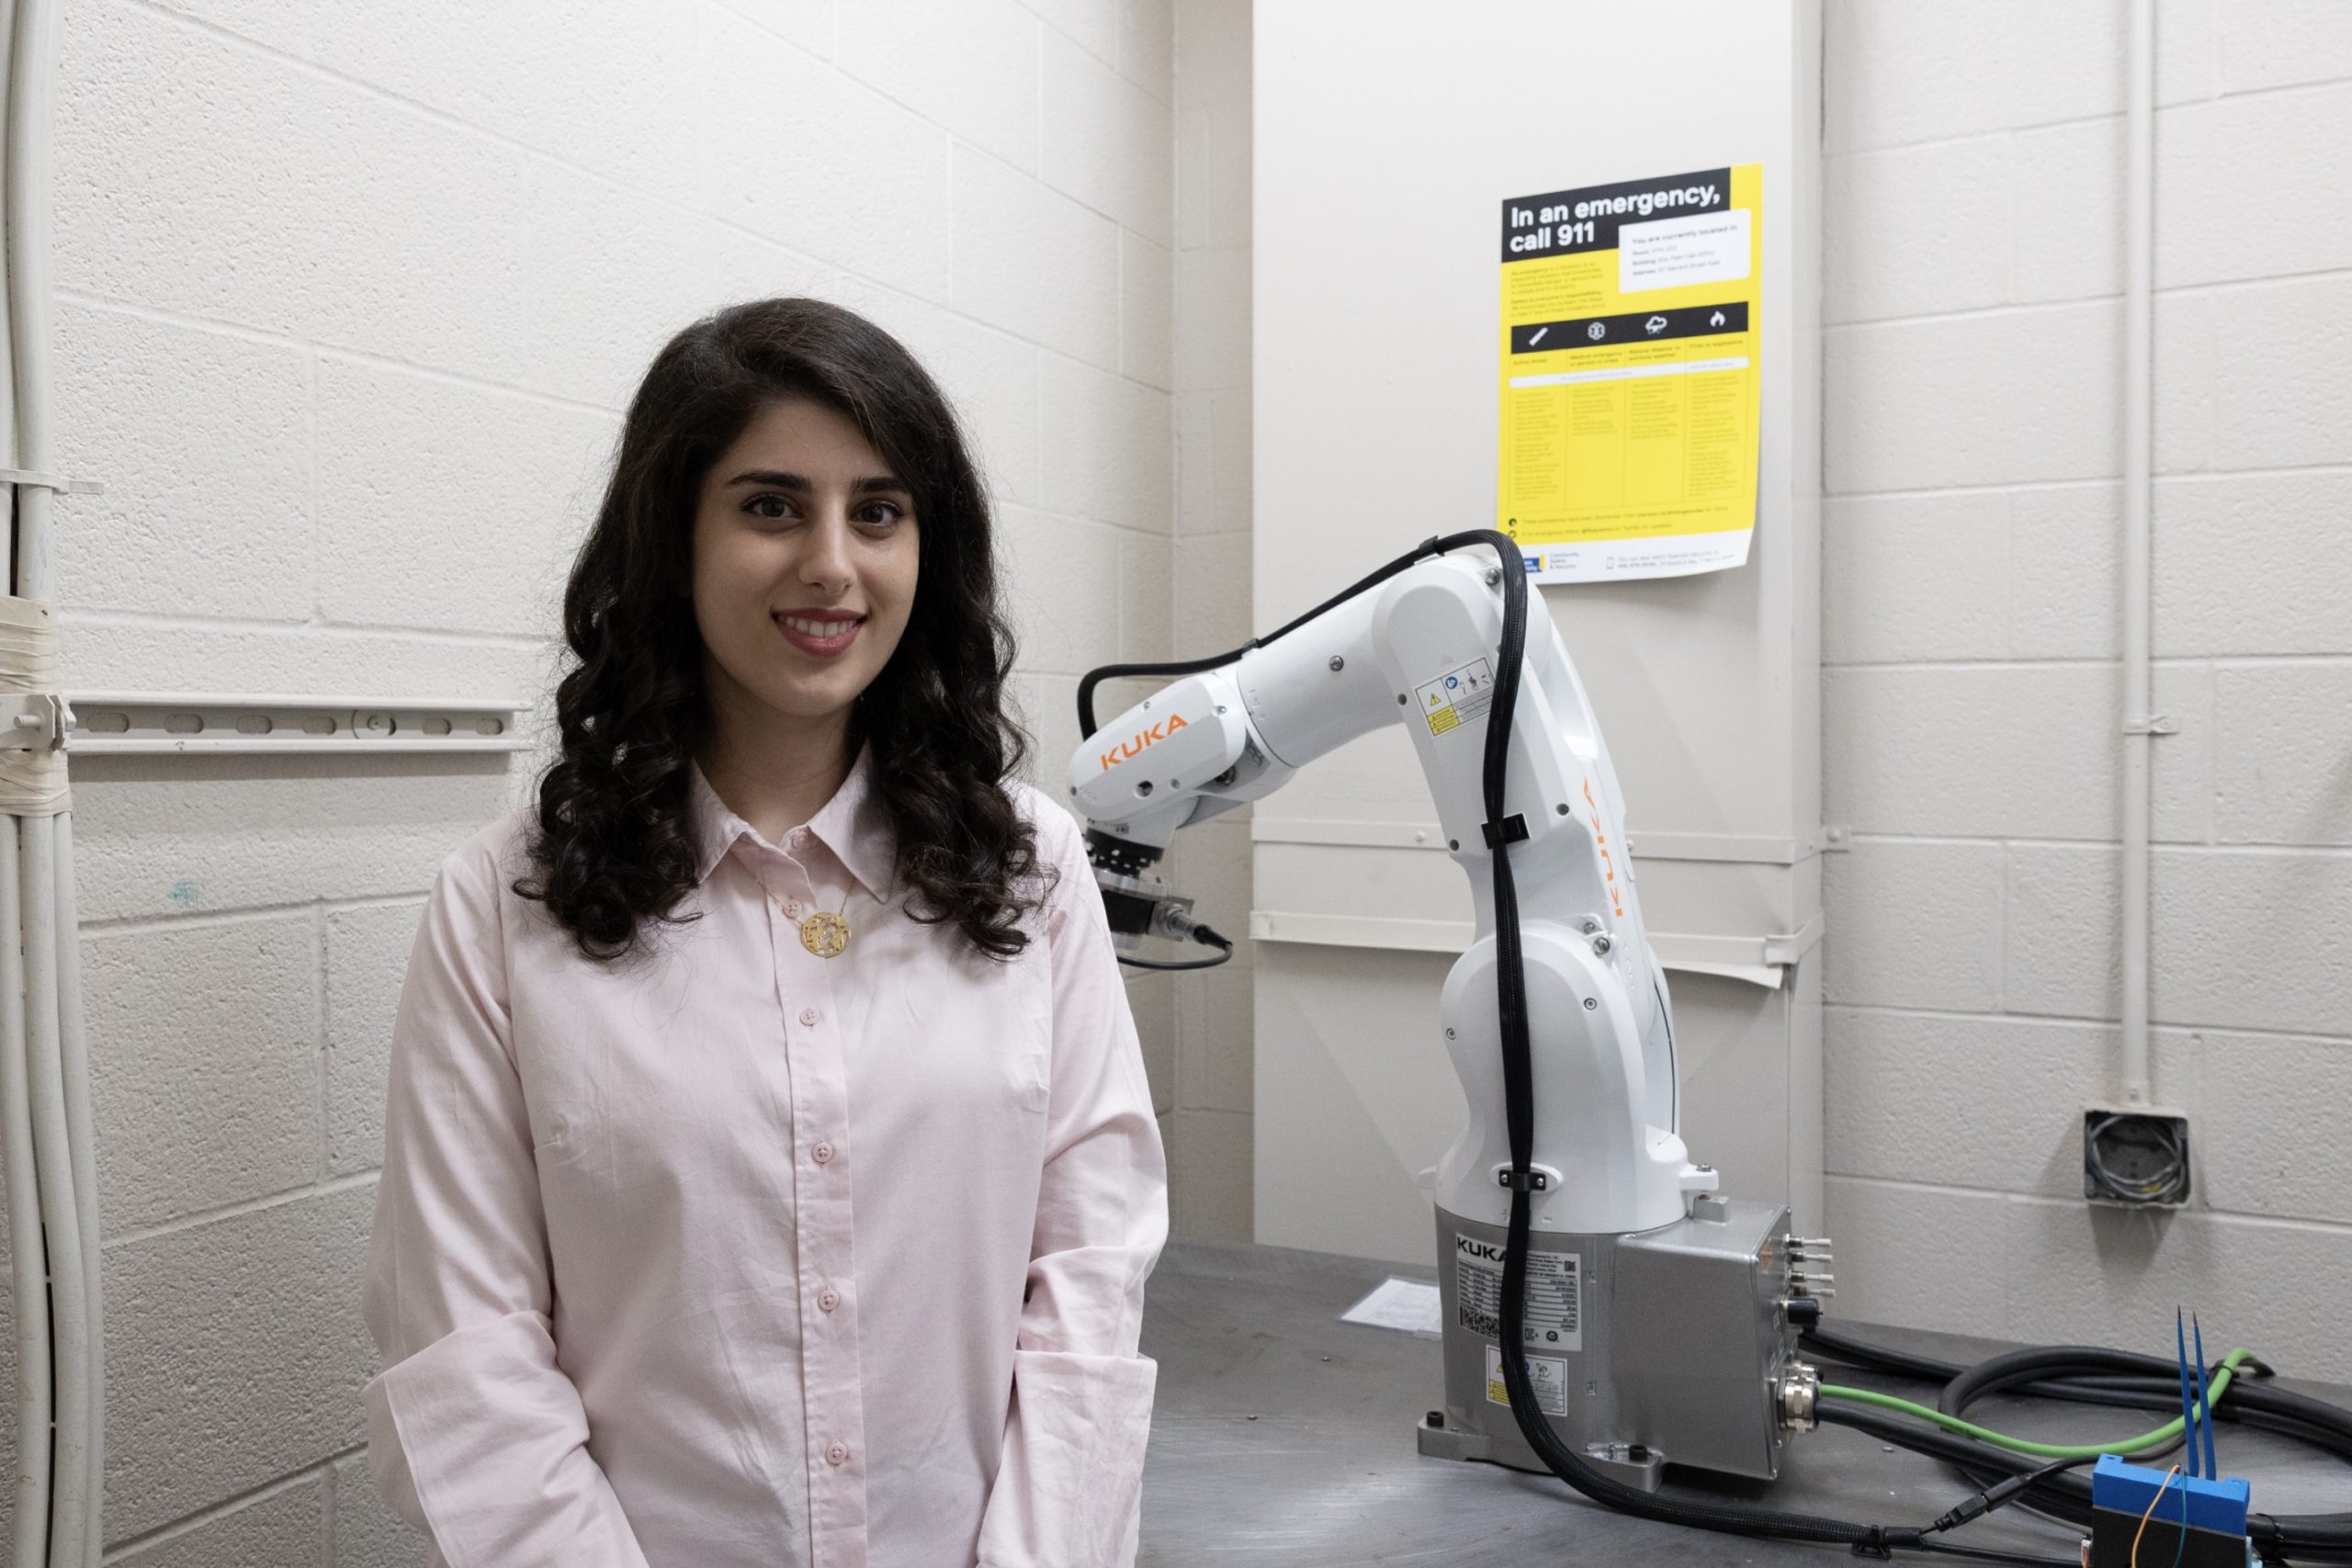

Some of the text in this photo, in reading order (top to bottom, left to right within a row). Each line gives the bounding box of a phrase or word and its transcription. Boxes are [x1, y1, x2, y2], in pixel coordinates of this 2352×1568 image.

[1511, 185, 1721, 228] In an emergency,
[1510, 221, 1595, 253] call 911
[1102, 714, 1188, 772] KUKA
